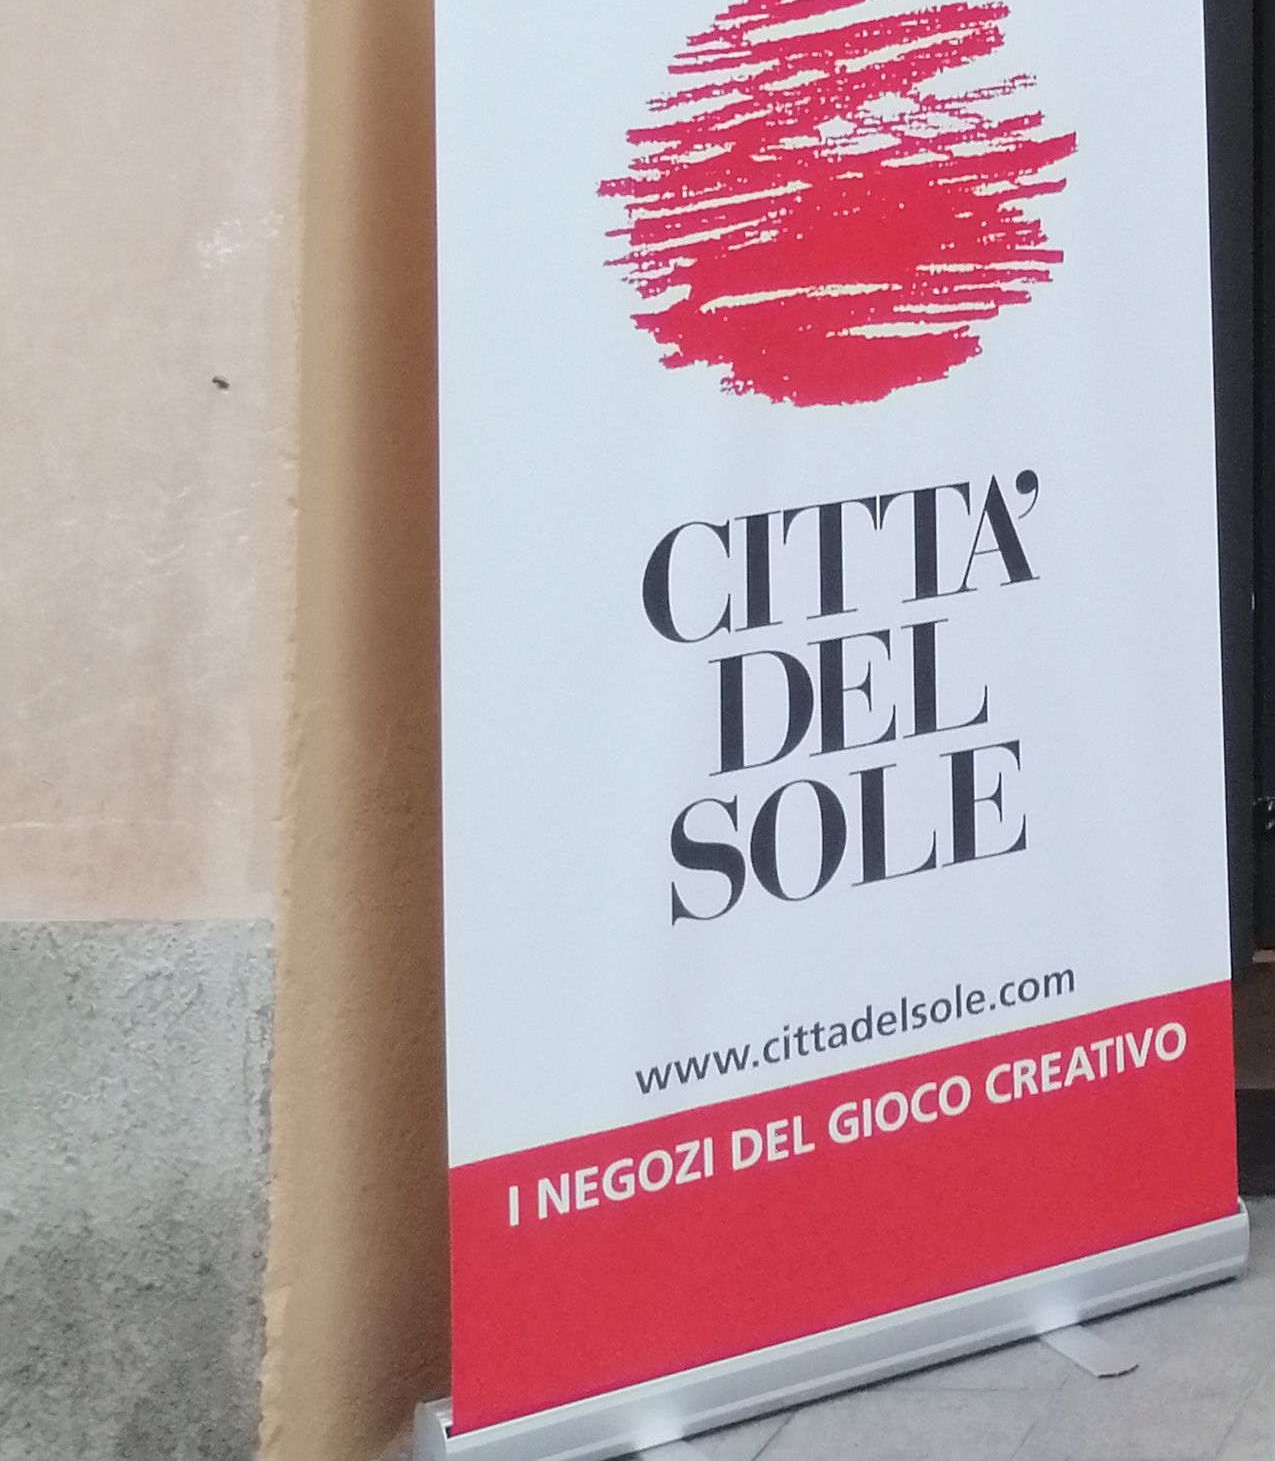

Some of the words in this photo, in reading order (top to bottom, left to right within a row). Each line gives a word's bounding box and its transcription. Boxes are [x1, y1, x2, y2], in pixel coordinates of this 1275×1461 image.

[641, 468, 1041, 645] CITTA'
[708, 618, 990, 777] DEL
[670, 739, 1028, 927] SOLE
[635, 966, 1077, 1096] www.cittadelsole.com
[508, 1185, 519, 1227] I
[537, 1137, 714, 1218] NEGOZI
[731, 1115, 816, 1173] DEL
[828, 1074, 972, 1145] GIOCO
[984, 1020, 1188, 1106] CREATIVO
